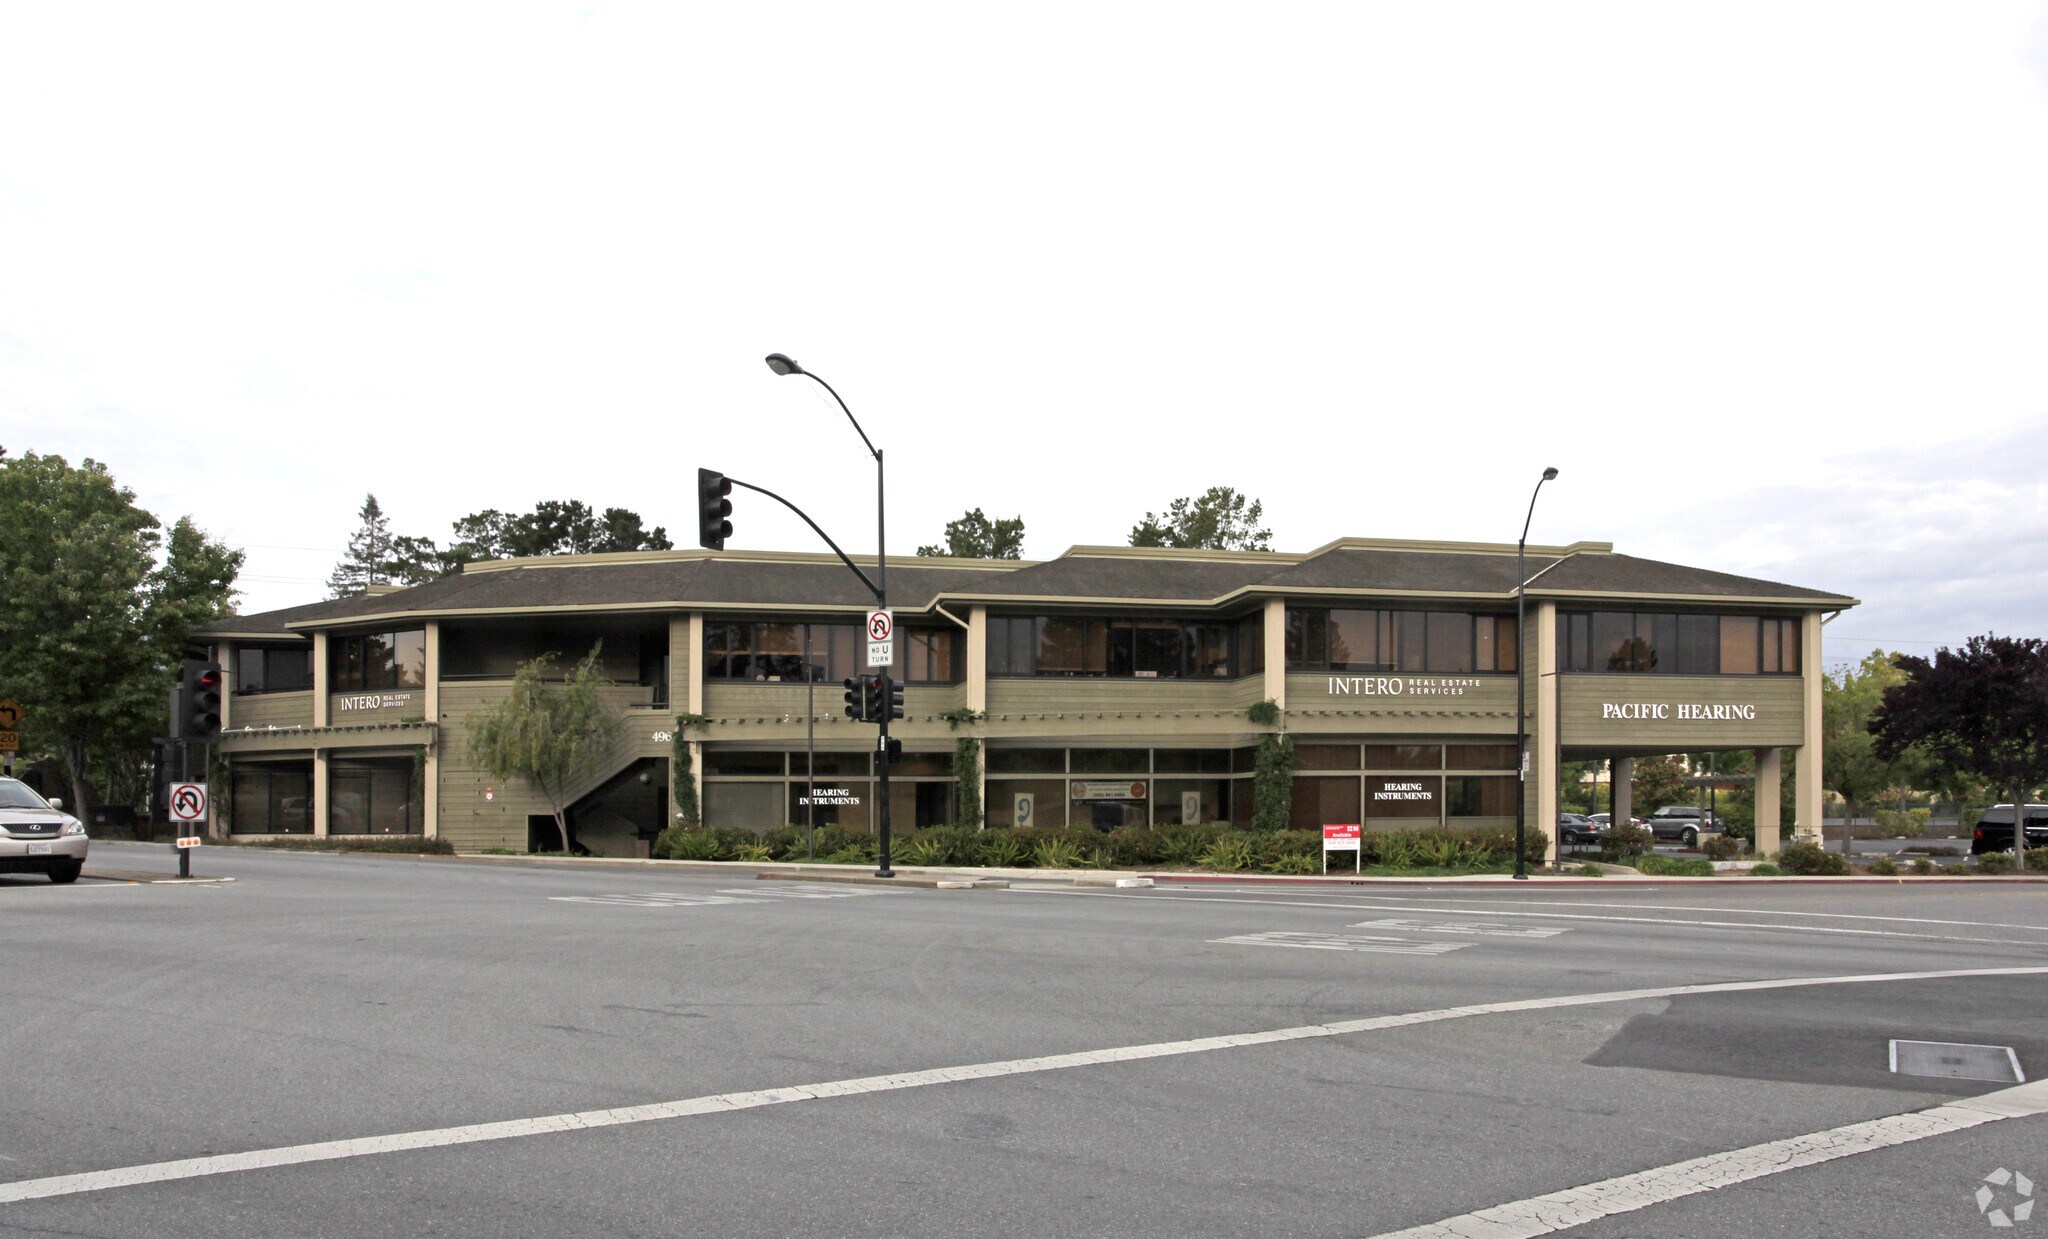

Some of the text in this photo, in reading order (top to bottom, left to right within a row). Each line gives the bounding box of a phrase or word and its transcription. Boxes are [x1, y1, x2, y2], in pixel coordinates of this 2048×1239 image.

[882, 645, 889, 654] U
[1328, 677, 1403, 695] INTERO
[1441, 679, 1481, 687] ESTATE
[341, 695, 381, 711] INTERO
[383, 700, 404, 708] SERVICES
[1602, 703, 1755, 720] PACIFIC HEARING
[0, 733, 16, 743] 20
[651, 731, 673, 742] 496
[1384, 783, 1422, 791] HEARING
[1374, 792, 1432, 800] INSTRUMENTS
[799, 797, 860, 805] INTRUMENTS
